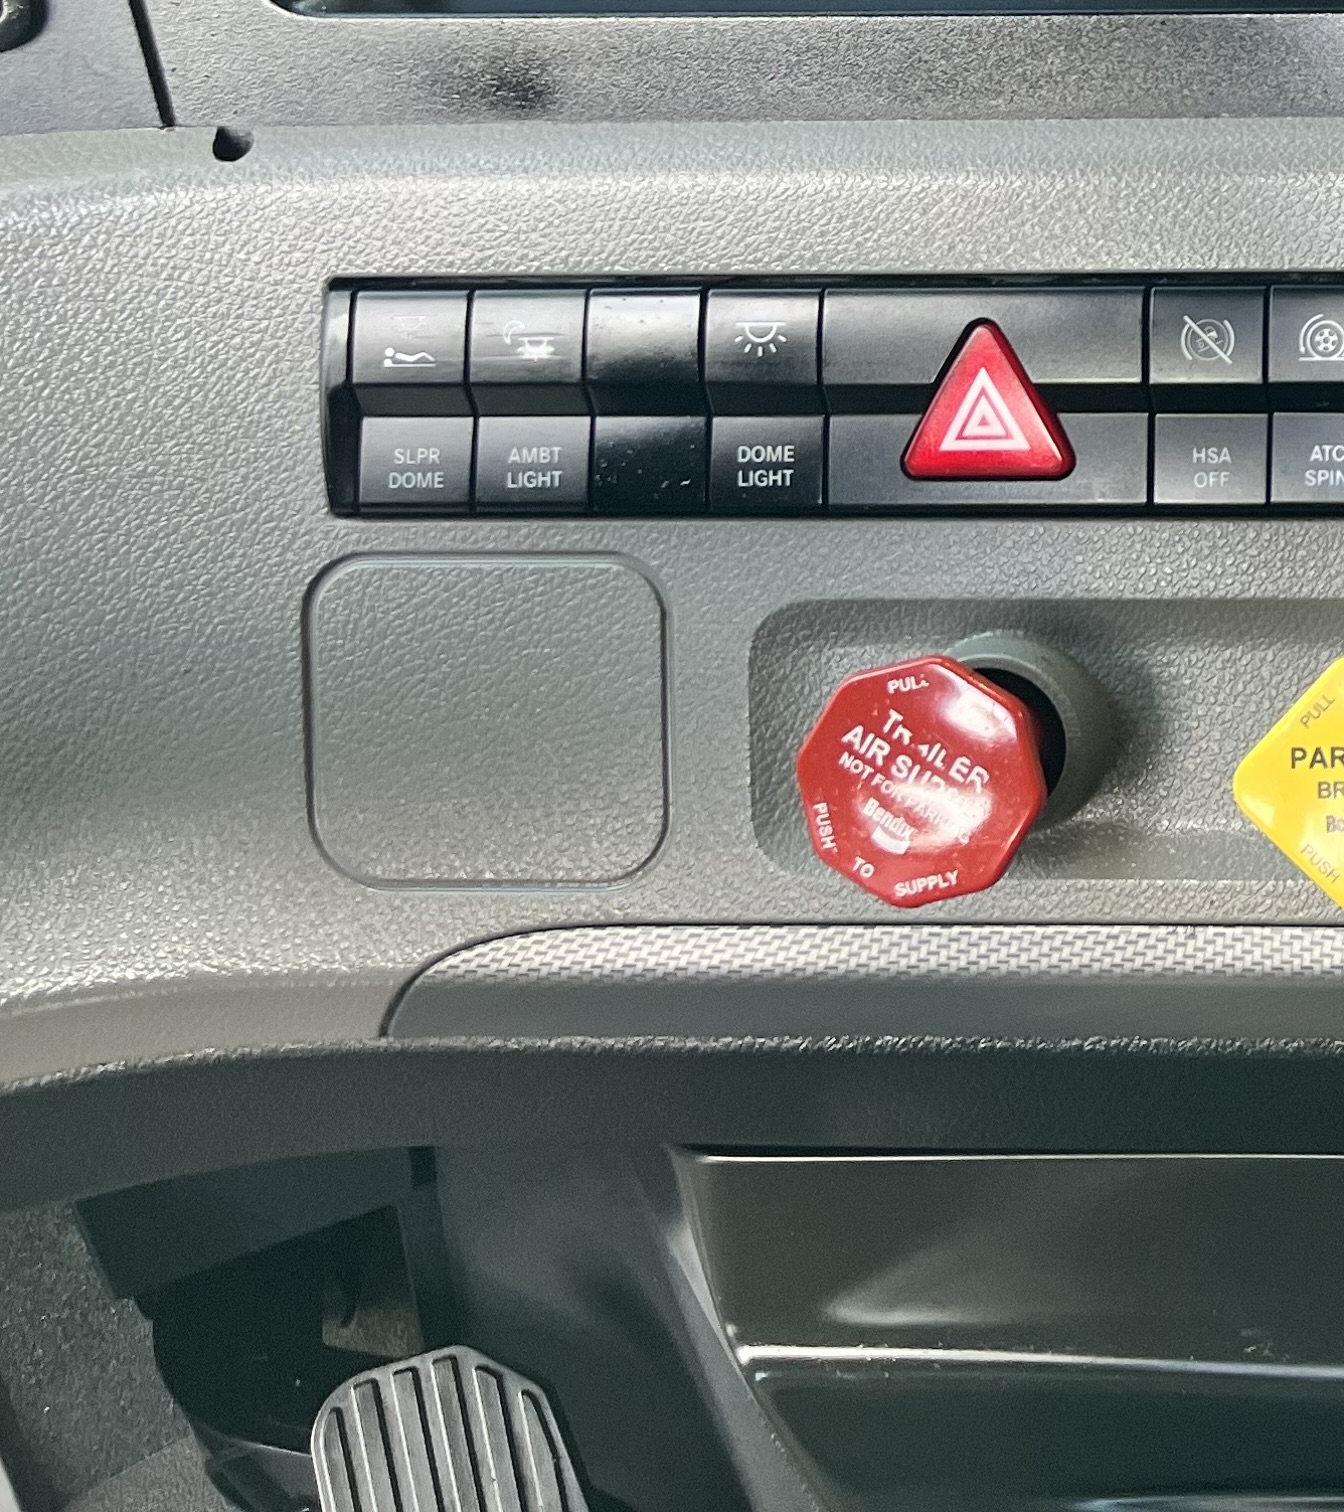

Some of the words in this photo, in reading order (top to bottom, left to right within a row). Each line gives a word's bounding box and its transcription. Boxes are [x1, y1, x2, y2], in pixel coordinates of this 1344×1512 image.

[393, 447, 441, 465] SLPR
[508, 445, 562, 463] AMBT
[737, 444, 795, 463] DOME
[1192, 446, 1232, 464] HSA
[388, 471, 445, 489] DOME
[506, 470, 562, 488] LIGHT
[737, 468, 794, 487] LIGHT
[1194, 471, 1230, 488] OFF
[1300, 694, 1336, 730] PULL
[840, 724, 891, 767] AIR
[838, 751, 875, 781] NOT
[870, 772, 902, 803] FOR
[862, 796, 918, 842] Bendix
[813, 801, 838, 850] PUSH
[852, 855, 875, 879] TO
[894, 869, 960, 898] SUPPLY
[1300, 842, 1342, 884] PUSH
